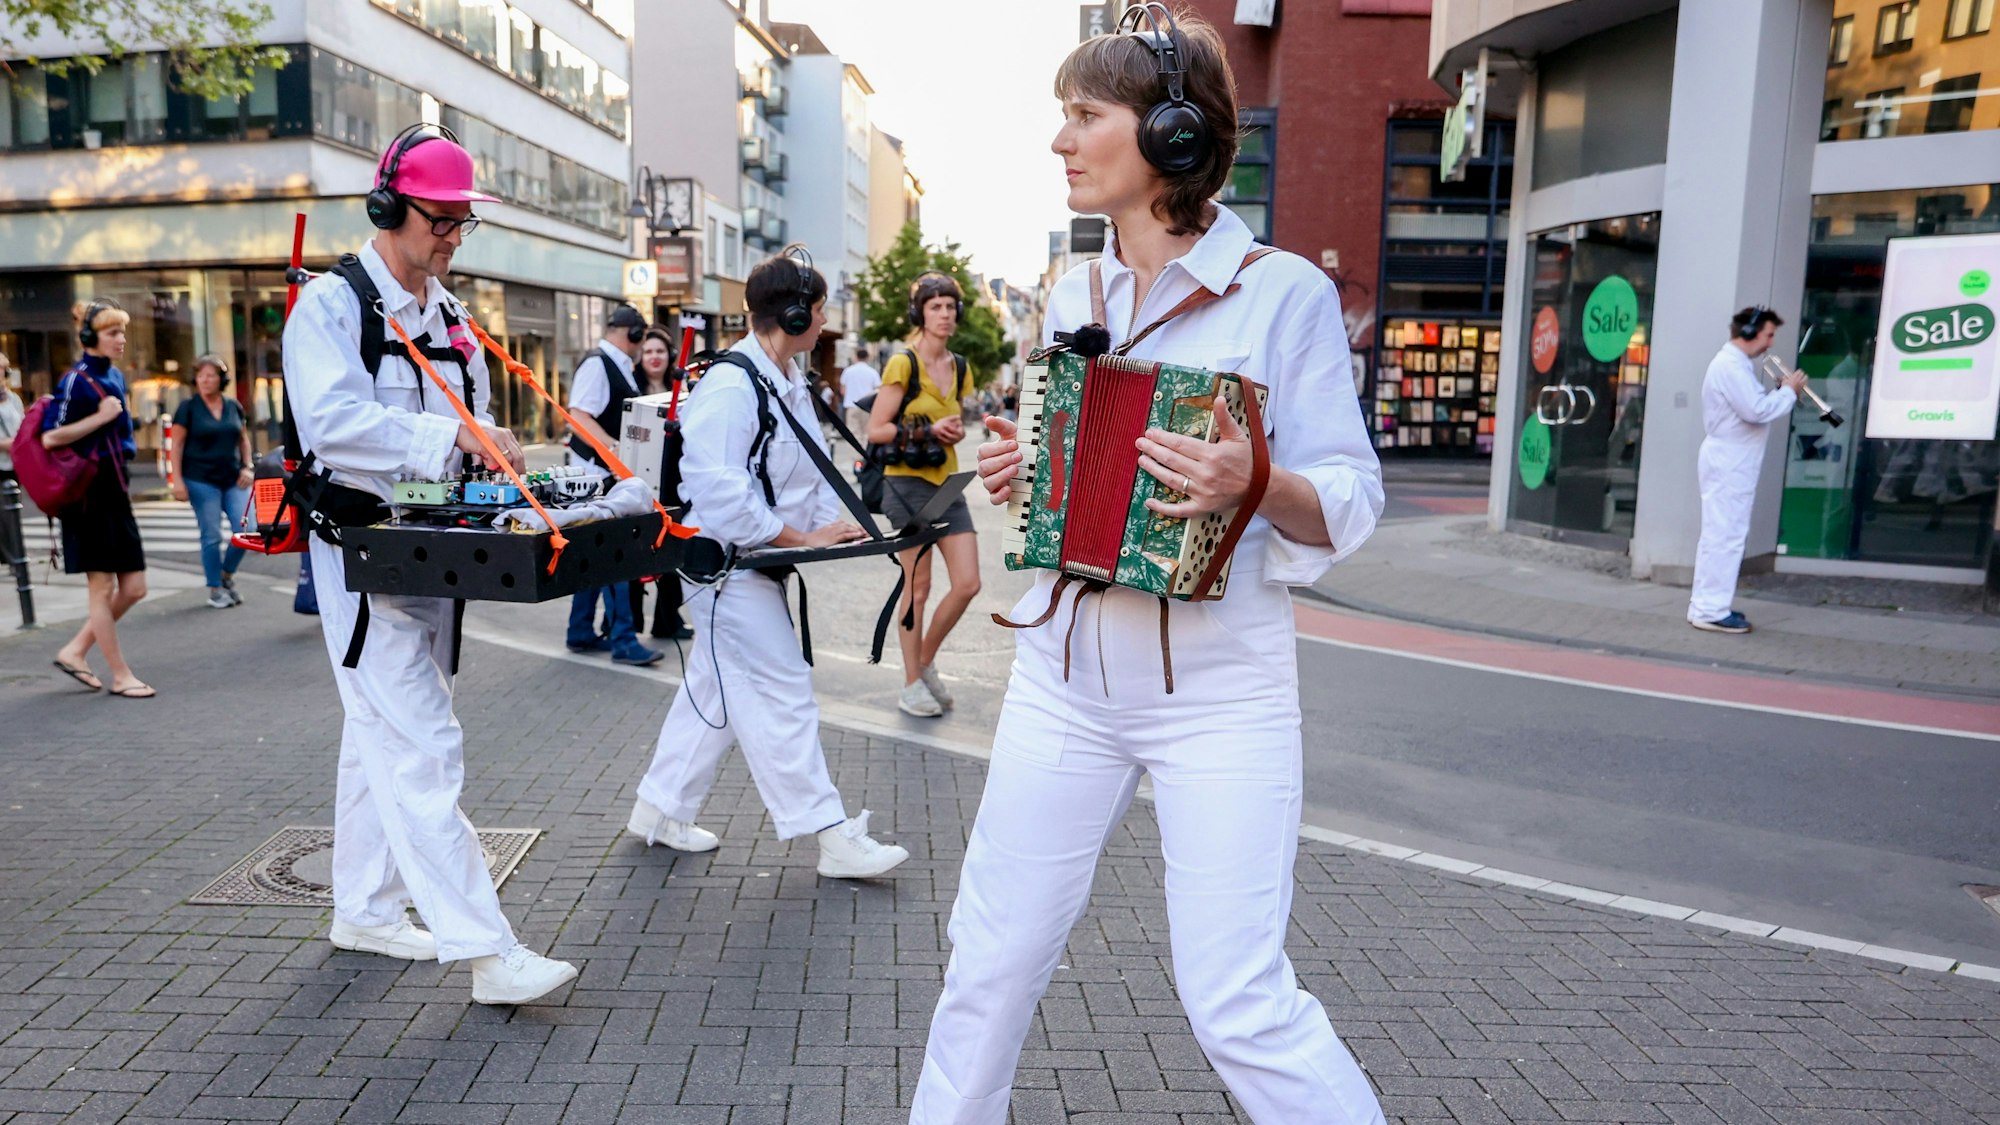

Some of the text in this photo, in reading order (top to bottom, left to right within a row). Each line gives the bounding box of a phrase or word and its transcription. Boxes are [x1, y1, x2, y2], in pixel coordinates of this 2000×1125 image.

[1588, 305, 1630, 334] Sale
[1904, 310, 1984, 348] Sale
[1907, 409, 1955, 422] Gravis
[1522, 437, 1546, 464] Sale
